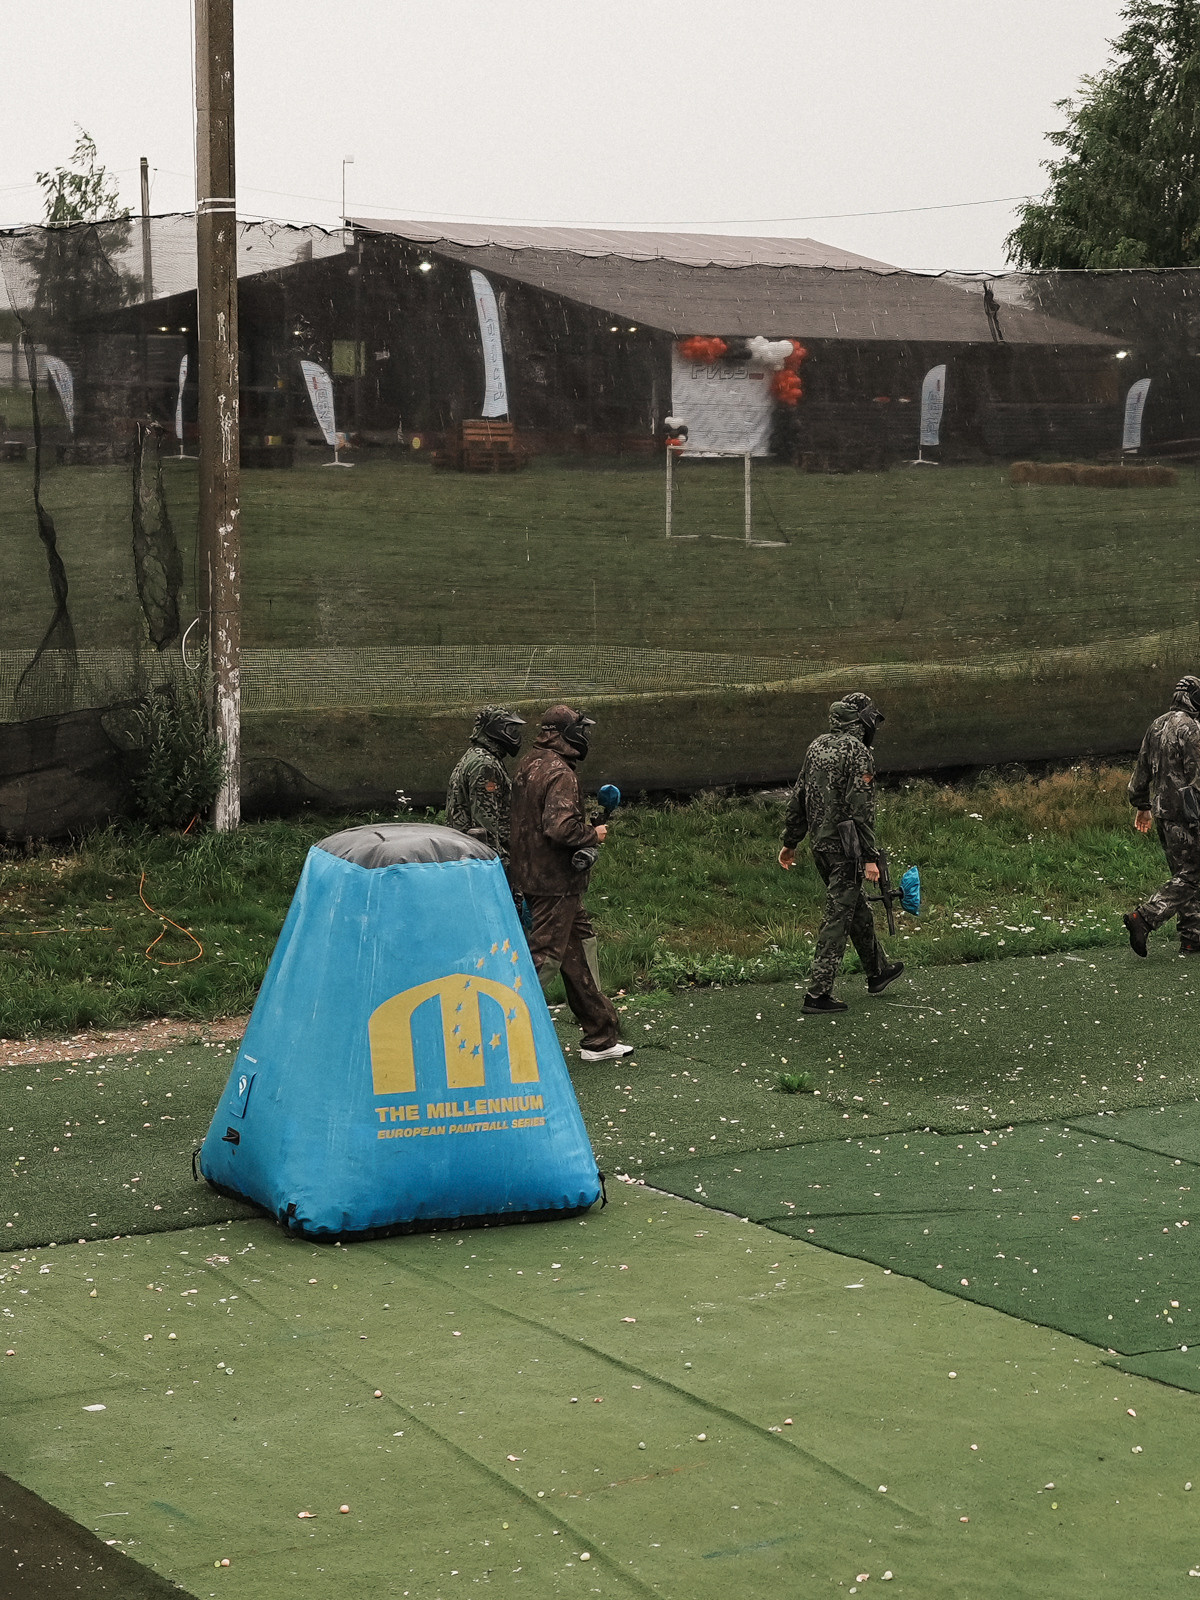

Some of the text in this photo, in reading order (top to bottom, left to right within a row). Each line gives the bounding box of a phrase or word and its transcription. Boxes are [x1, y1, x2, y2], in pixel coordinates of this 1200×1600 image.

[375, 1095, 544, 1122] THE MILLENNIUM
[377, 1117, 546, 1140] EUROPEAN PAINTBALL SERIES
